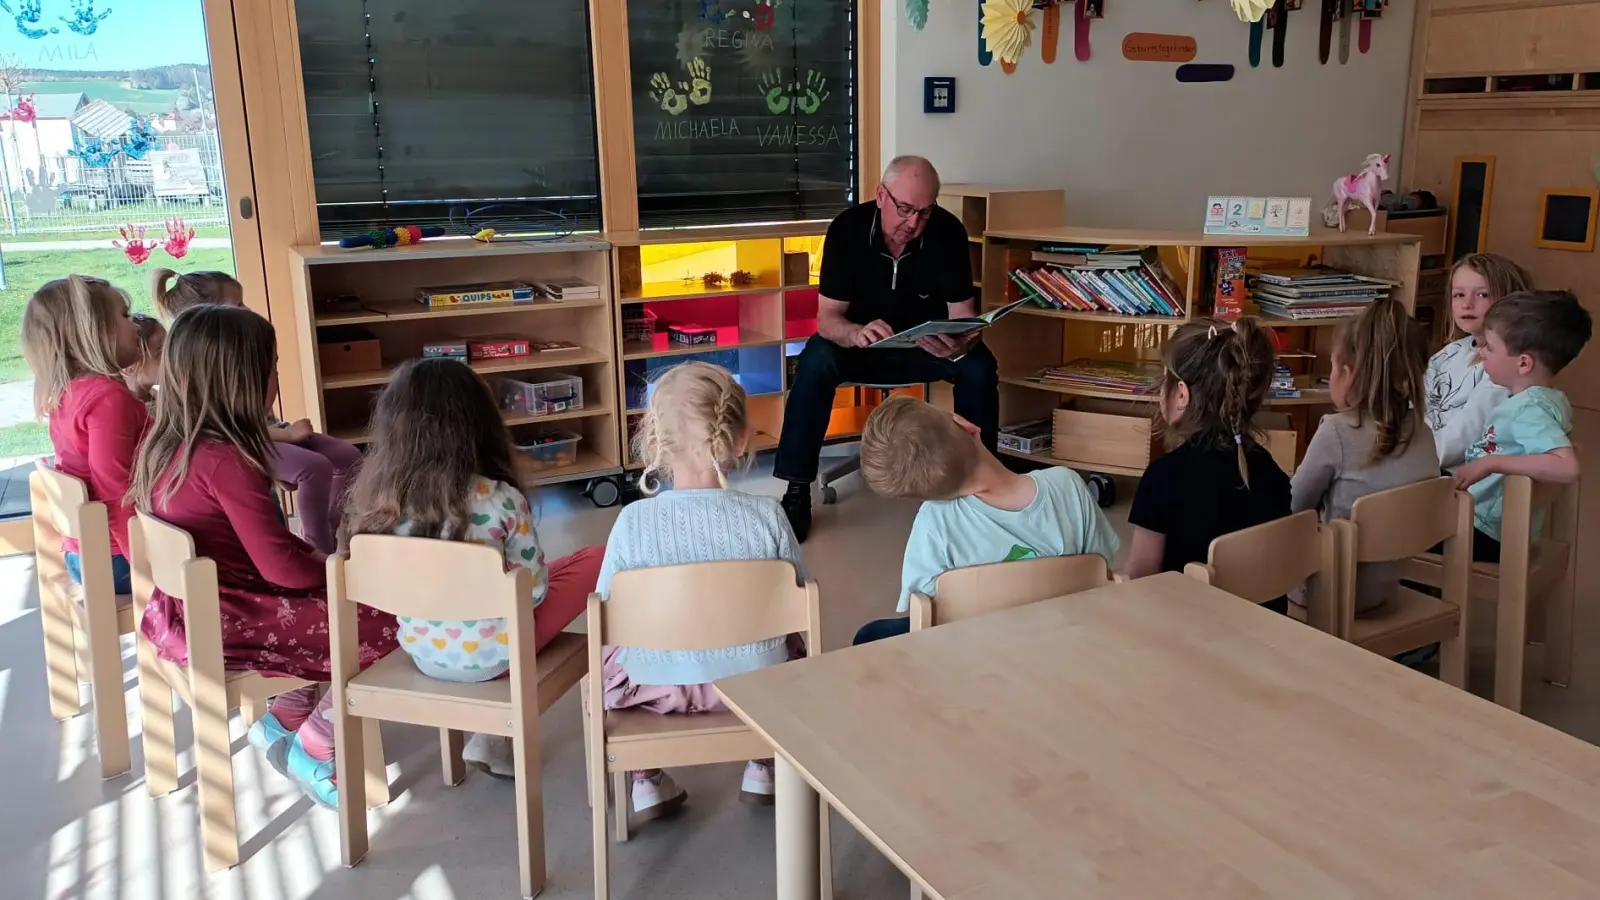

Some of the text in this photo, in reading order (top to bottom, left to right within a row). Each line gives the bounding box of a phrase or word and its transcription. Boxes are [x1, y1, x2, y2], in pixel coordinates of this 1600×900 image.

[705, 28, 774, 50] REGINA
[38, 43, 99, 62] MILA
[655, 117, 741, 141] MICHAELA
[757, 124, 841, 147] VANESSA
[1233, 203, 1242, 216] 2
[462, 292, 492, 303] QUIPS
